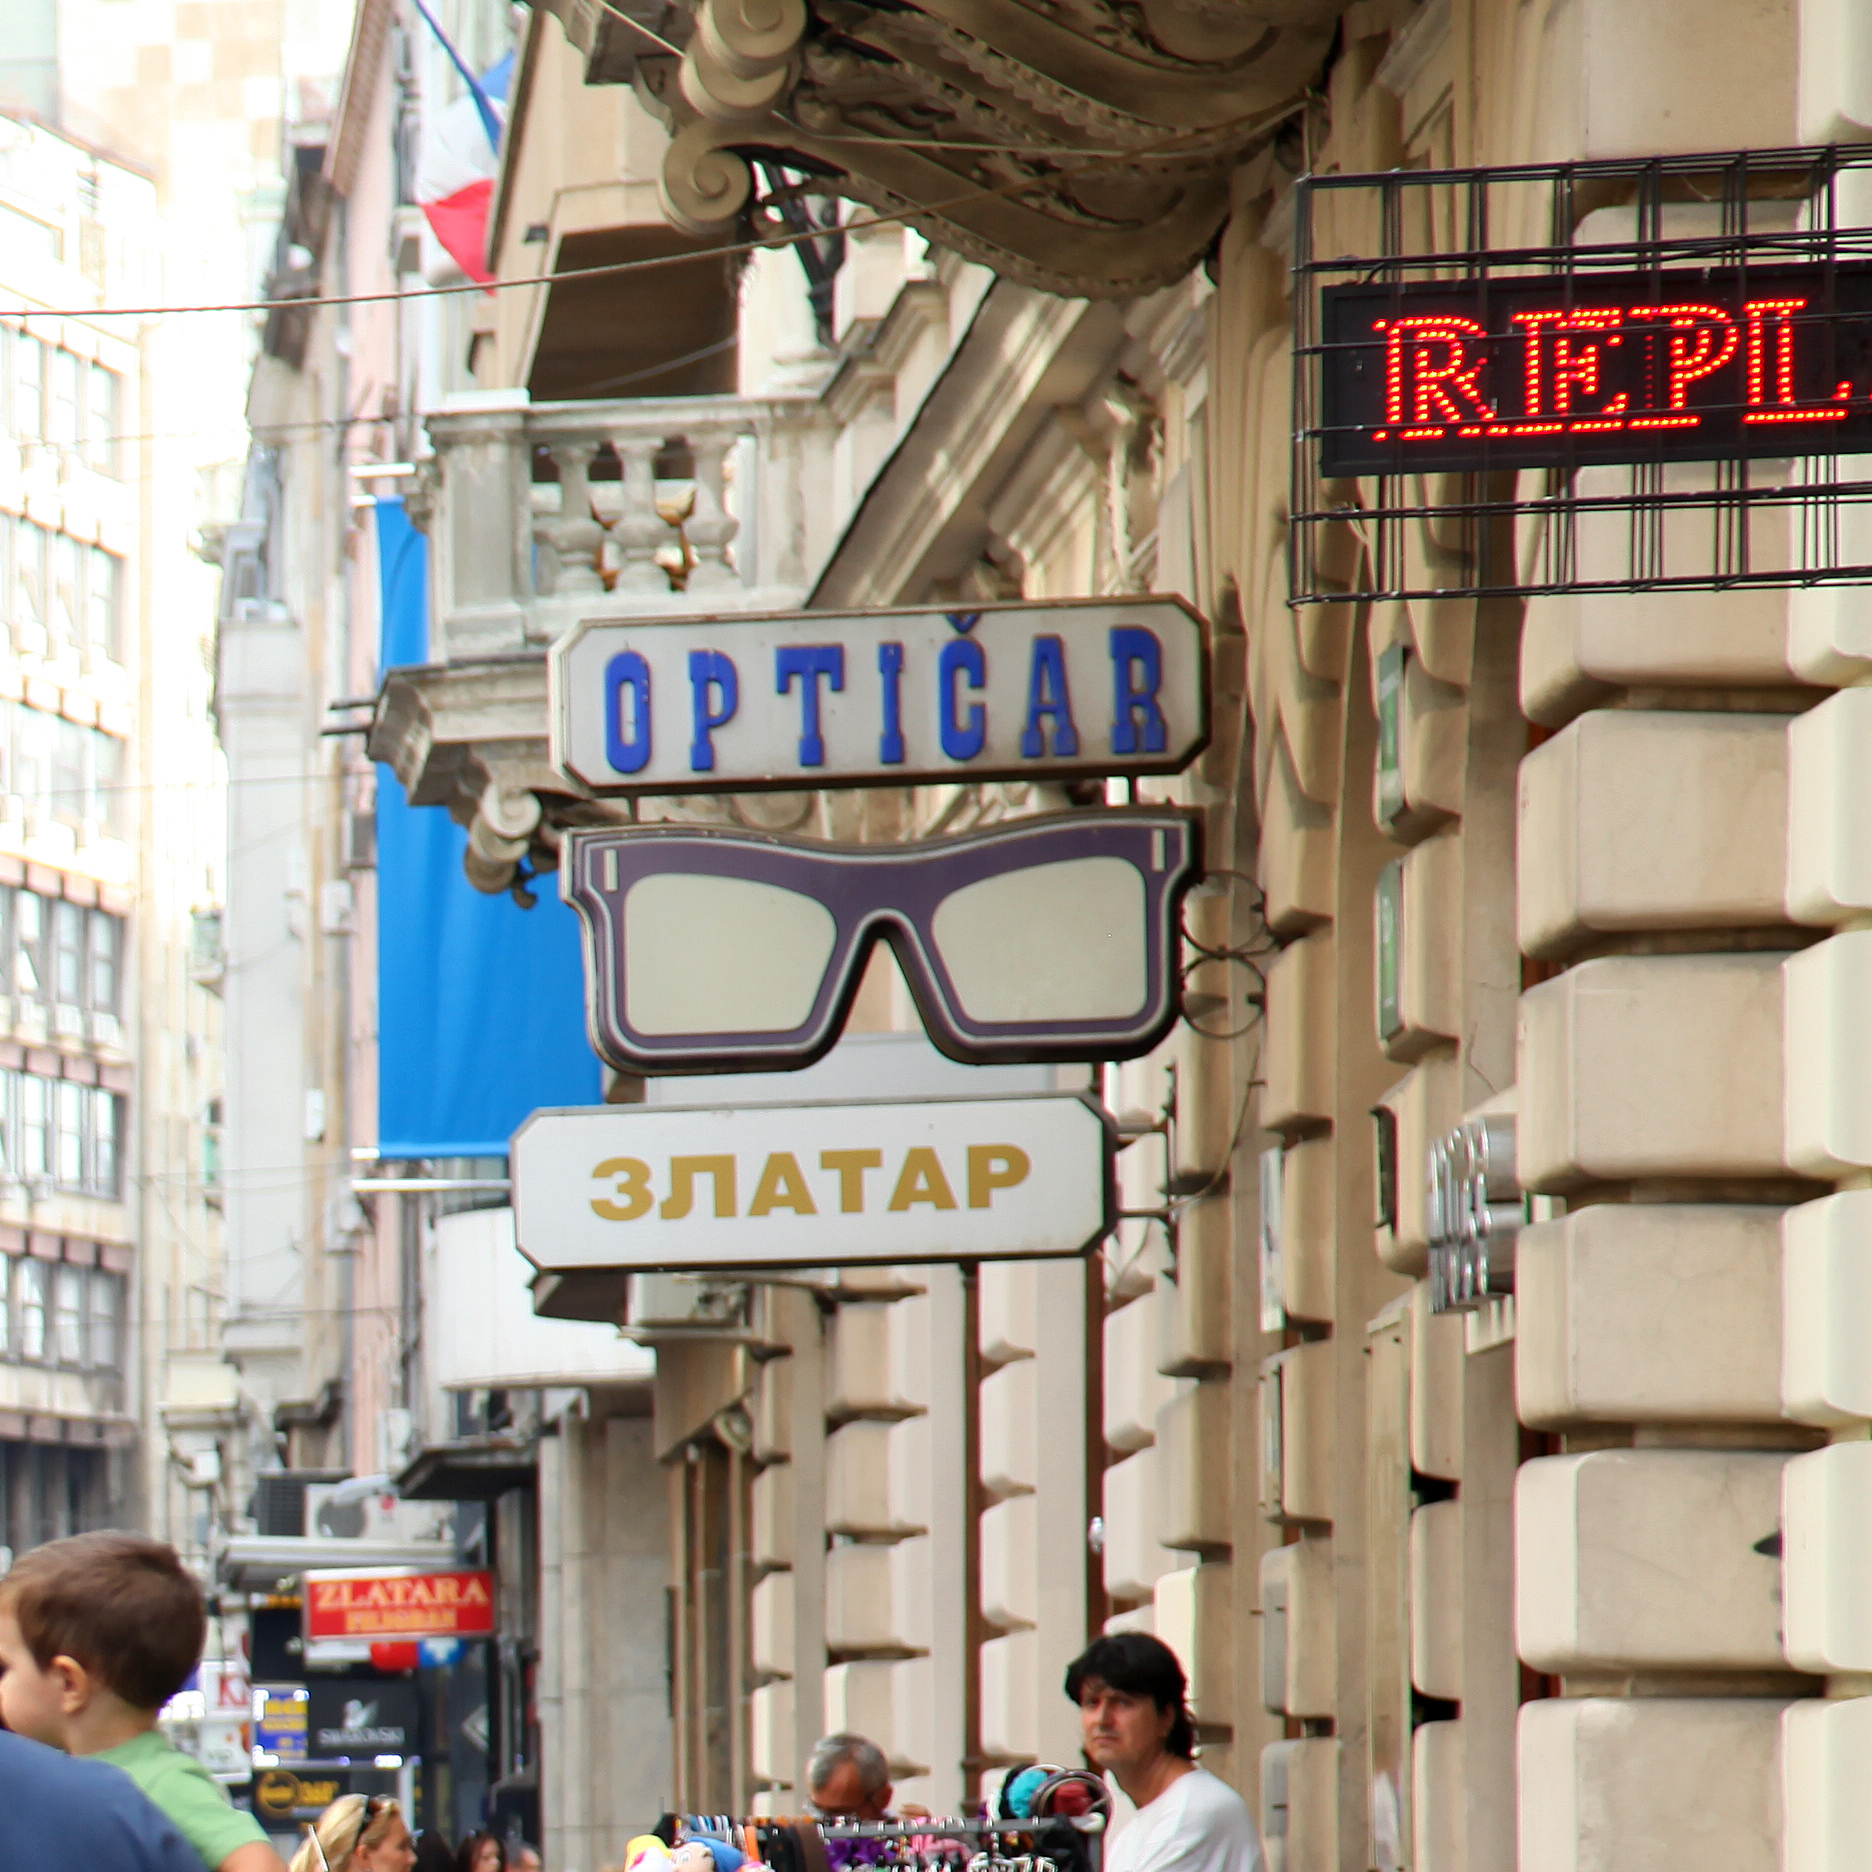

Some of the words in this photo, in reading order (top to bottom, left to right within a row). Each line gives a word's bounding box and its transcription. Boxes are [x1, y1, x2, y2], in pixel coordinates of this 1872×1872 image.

[603, 611, 1171, 774] OPTIČAR
[589, 1142, 1033, 1222] ЗЛАТАР
[316, 1577, 490, 1608] ZLATARA
